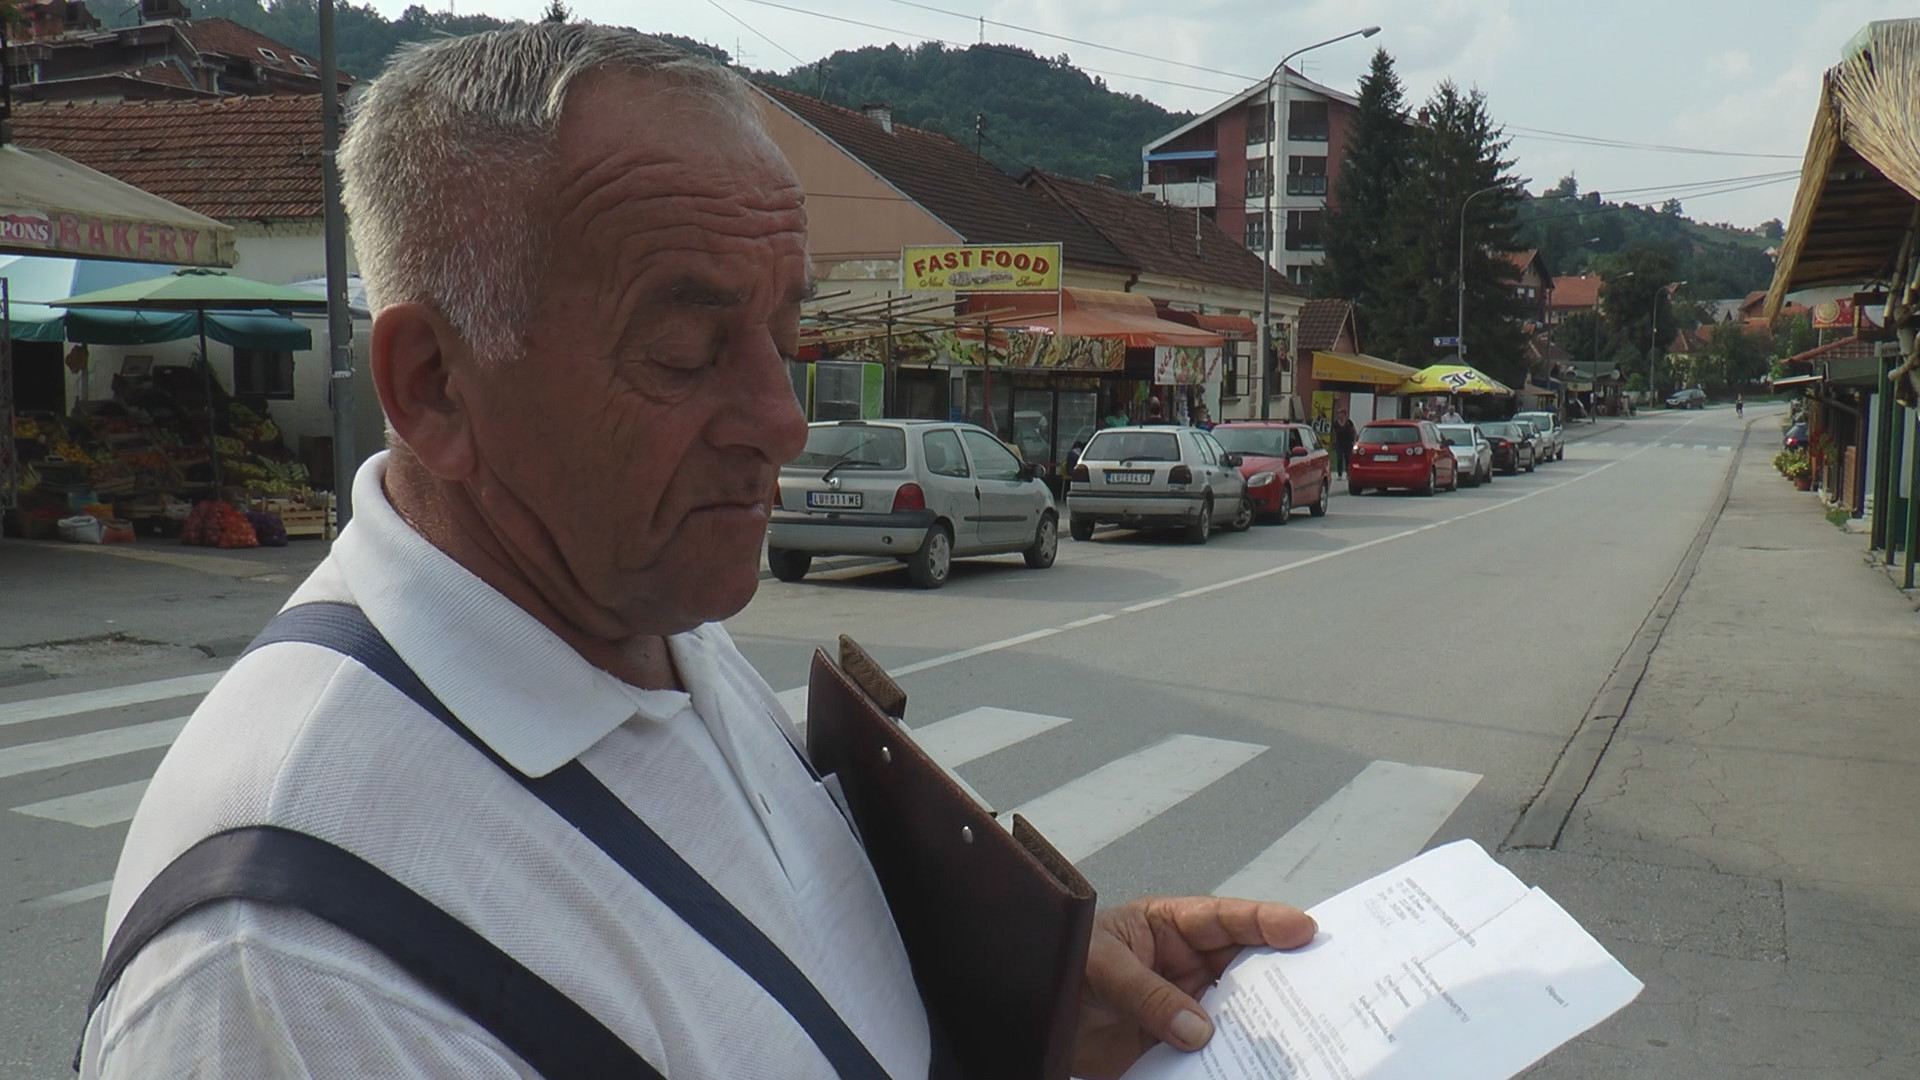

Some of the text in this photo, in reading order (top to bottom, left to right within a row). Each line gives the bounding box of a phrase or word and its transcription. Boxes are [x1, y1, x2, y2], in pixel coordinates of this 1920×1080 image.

[59, 213, 200, 260] BAKERY
[912, 249, 1050, 278] FAST FOOD
[814, 494, 824, 505] LU
